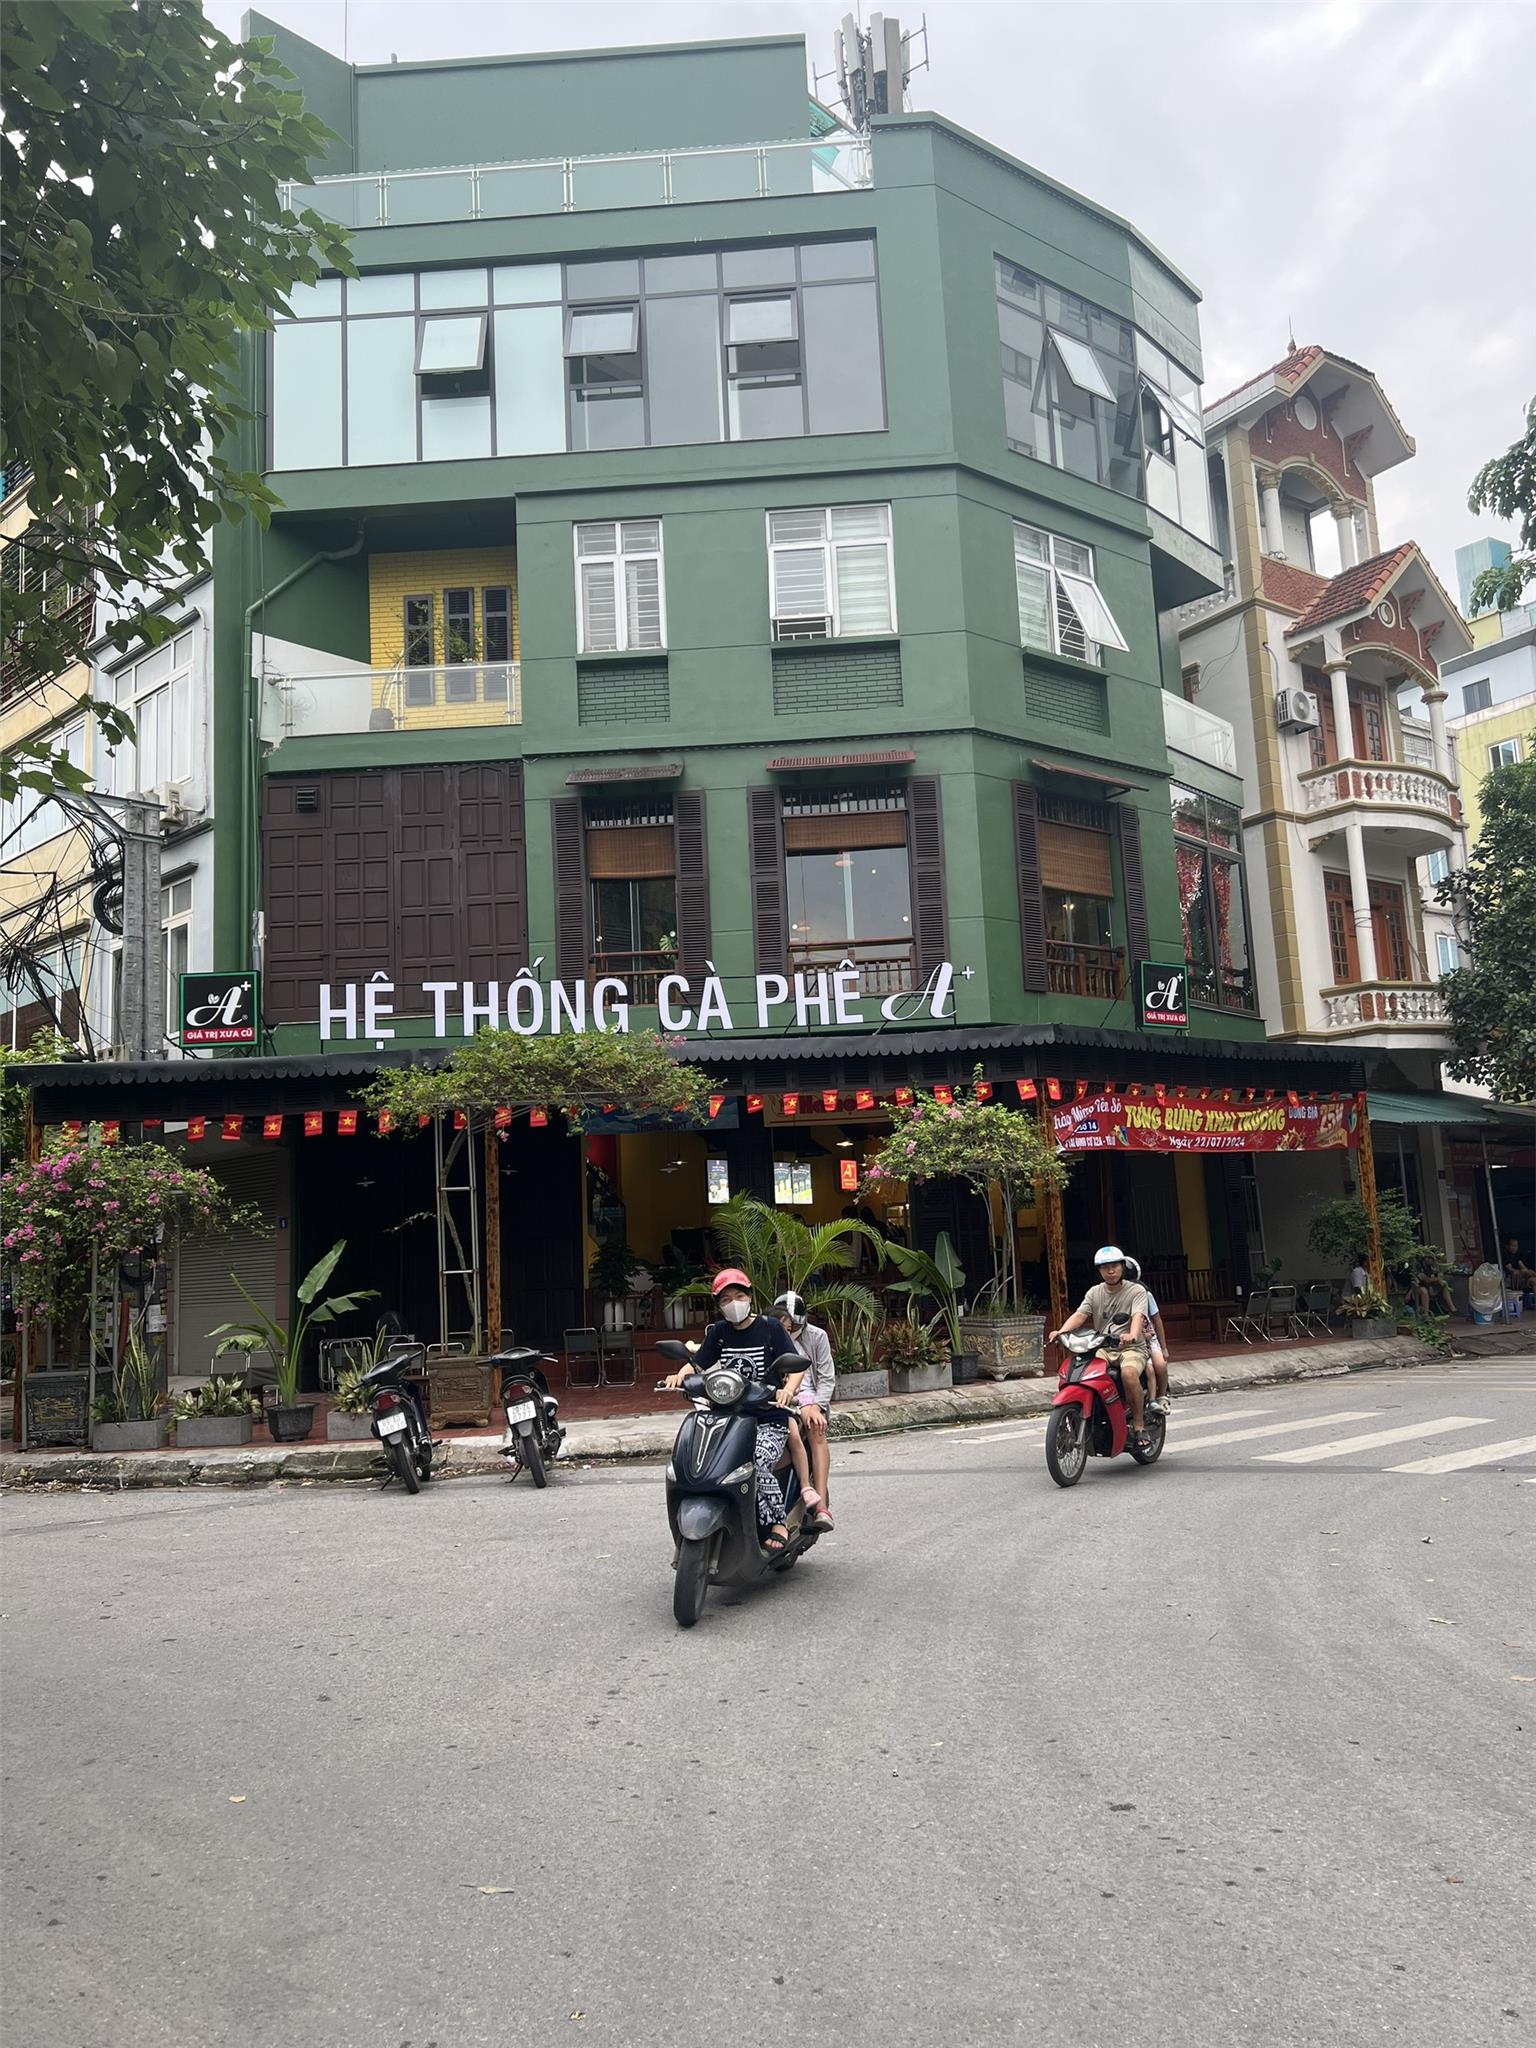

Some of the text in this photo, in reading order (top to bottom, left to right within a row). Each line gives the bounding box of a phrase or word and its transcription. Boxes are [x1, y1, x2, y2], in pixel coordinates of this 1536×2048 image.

[319, 971, 395, 1050] HỆ
[422, 956, 629, 1037] THỐNG
[658, 960, 733, 1031] CÀ
[756, 959, 863, 1028] PHÊ
[187, 1027, 253, 1040] GIÁ TRỊ XƯA CŨ
[1054, 1112, 1072, 1130] hào
[1088, 1121, 1098, 1130] 14
[1169, 1136, 1246, 1149] Ngày 22/07/2024
